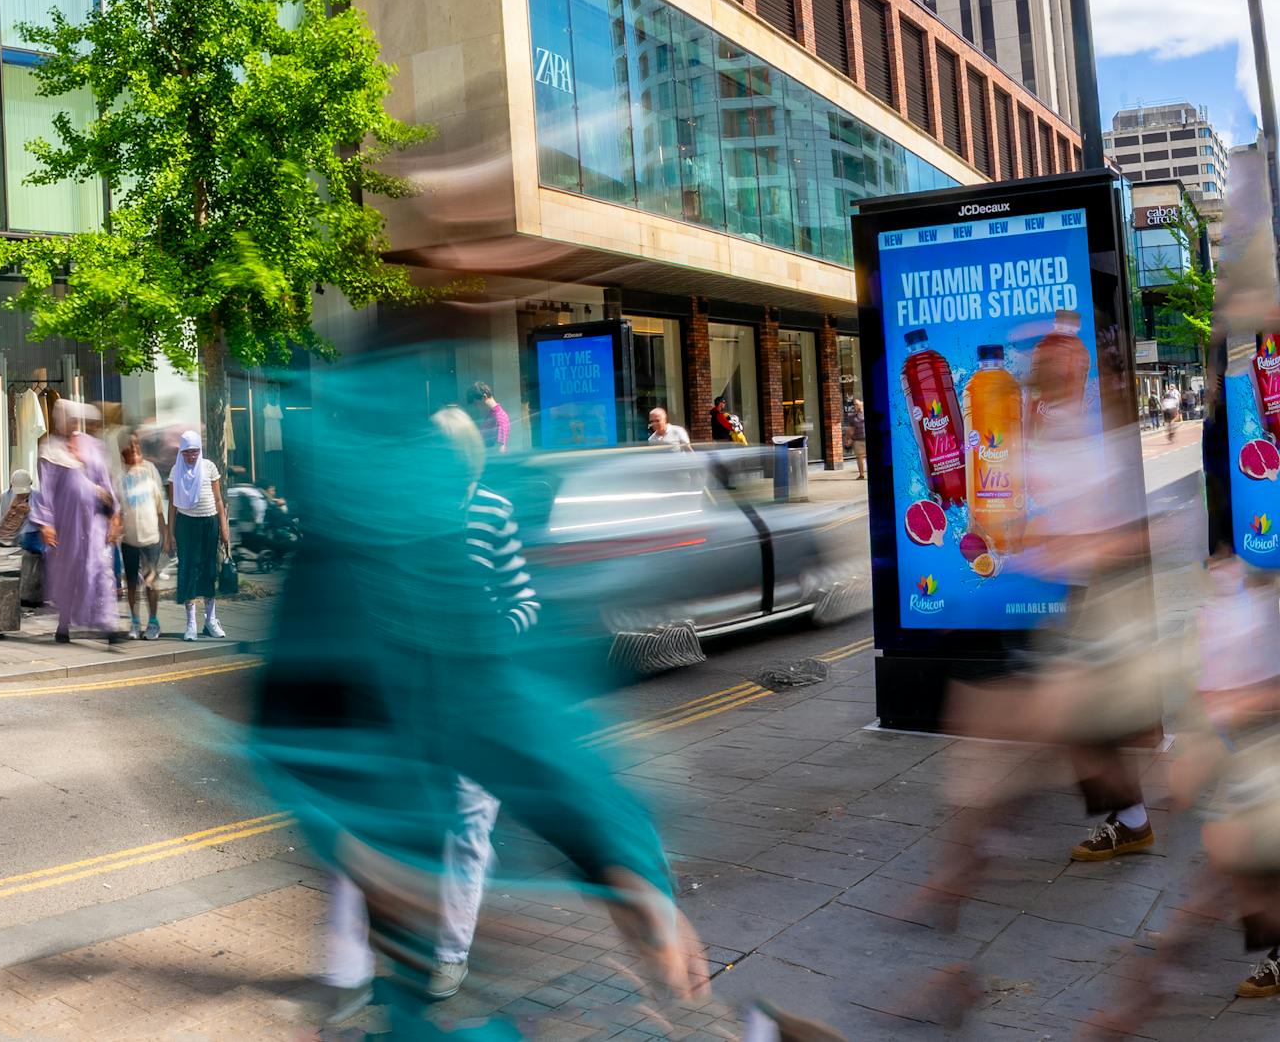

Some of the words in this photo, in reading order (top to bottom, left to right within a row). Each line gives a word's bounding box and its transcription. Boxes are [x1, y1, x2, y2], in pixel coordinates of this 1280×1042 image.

[535, 46, 574, 95] ZARA
[957, 202, 1011, 217] JCDecaux
[1146, 206, 1178, 218] cabot
[1147, 215, 1179, 226] circus
[884, 233, 903, 247] NEW
[918, 229, 938, 243] NEW
[952, 225, 973, 239] NEW
[988, 220, 1009, 235] NEW
[1024, 216, 1045, 231] NEW
[1061, 212, 1082, 227] NEW
[901, 265, 984, 299] VITAMIN
[989, 256, 1069, 289] PACKED
[897, 293, 982, 327] FLAVOUR
[988, 283, 1078, 319] STACKED
[550, 351, 572, 367] TRY
[575, 350, 593, 365] ME
[554, 366, 568, 381] AT
[570, 364, 601, 379] YOUR
[560, 380, 600, 395] LOCAL.
[923, 415, 949, 432] Rubicon
[927, 435, 956, 456] Vits
[978, 446, 1009, 461] Rubicon
[979, 467, 1010, 489] Vits
[1244, 533, 1278, 553] Rubicon
[910, 594, 945, 614] Rubicon
[1005, 602, 1047, 614] AVAILABLE
[1048, 601, 1068, 614] NOW
